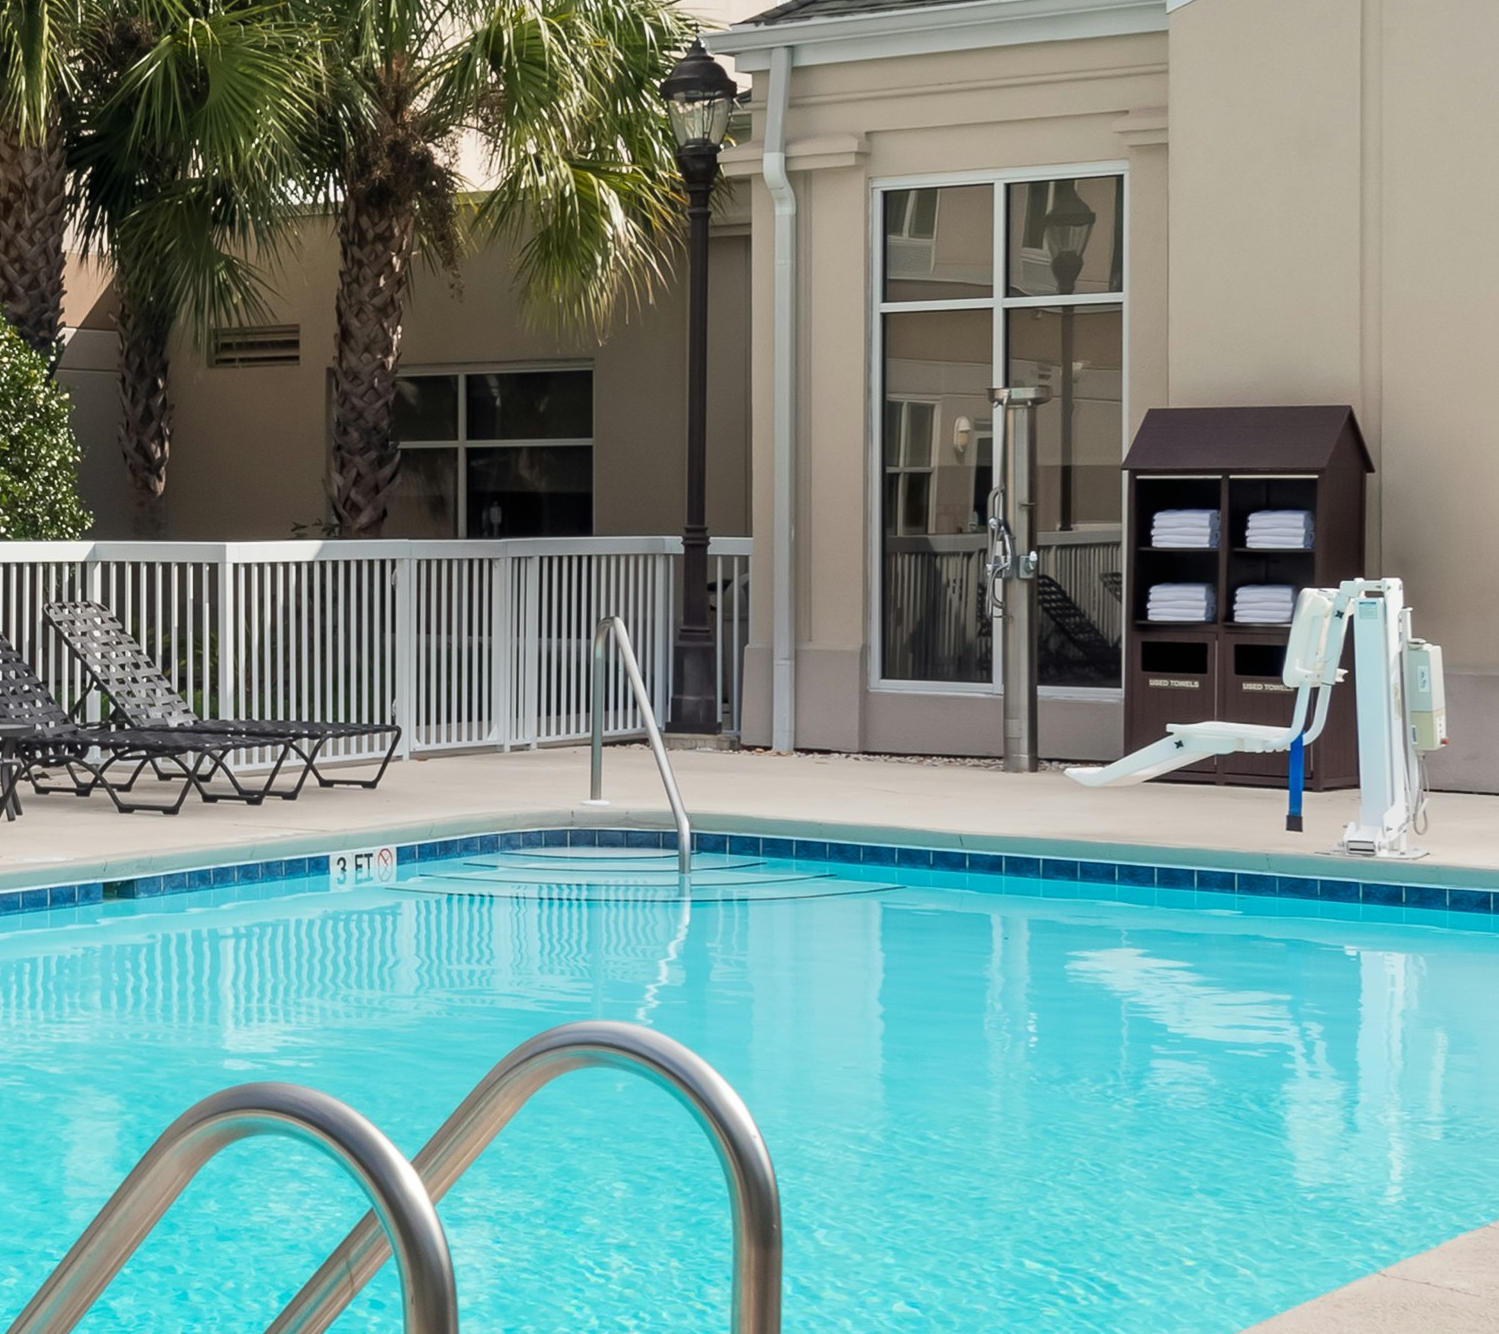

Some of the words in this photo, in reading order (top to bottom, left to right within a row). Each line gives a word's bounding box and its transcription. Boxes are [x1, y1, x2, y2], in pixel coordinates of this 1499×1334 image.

[1149, 679, 1170, 687] USED
[1170, 679, 1200, 688] TOWELS
[1242, 682, 1264, 690] USED
[336, 856, 347, 873] 3
[354, 853, 374, 872] FT
